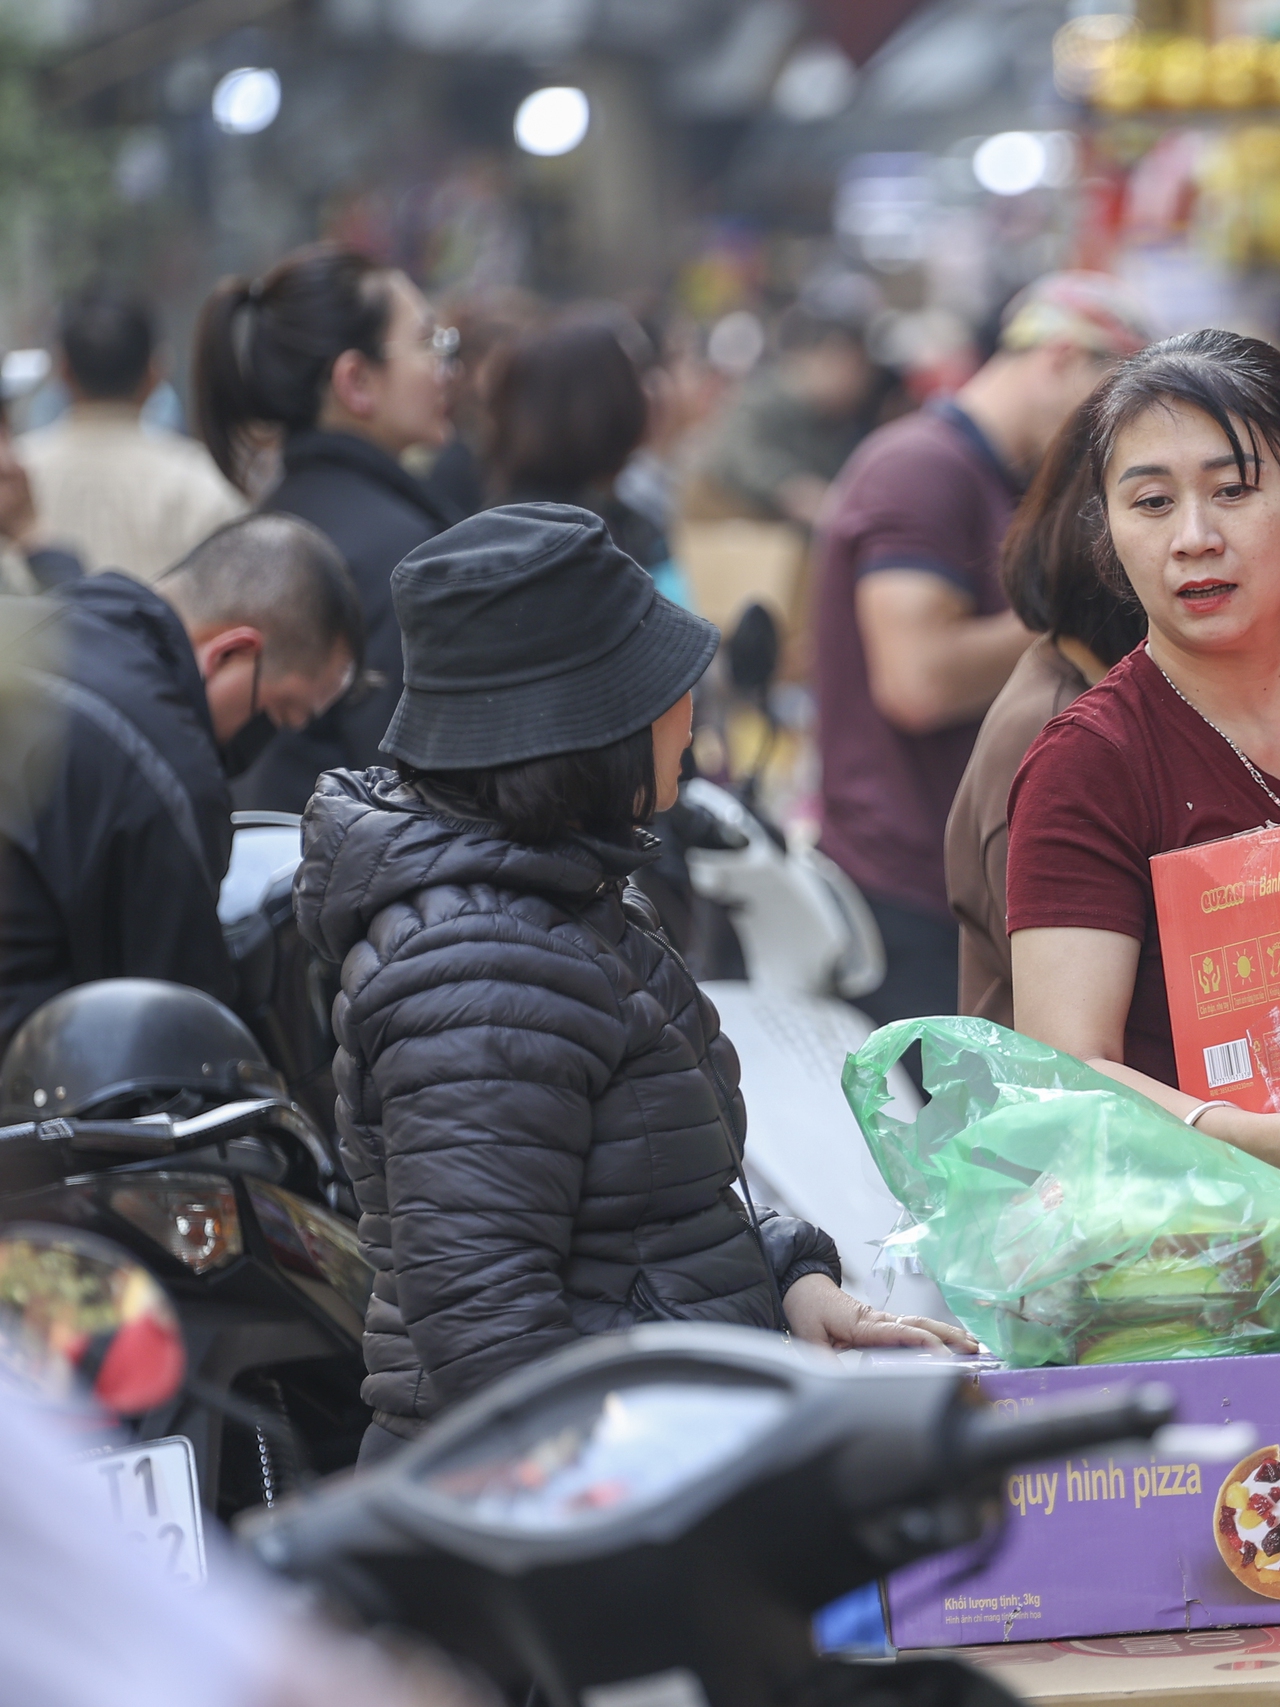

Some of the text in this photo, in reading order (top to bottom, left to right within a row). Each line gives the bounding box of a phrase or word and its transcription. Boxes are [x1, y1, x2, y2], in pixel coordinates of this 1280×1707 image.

[1007, 1455, 1202, 1516] quy hình pizza
[944, 1593, 1041, 1611] Khối lượng tịnh: 3kg
